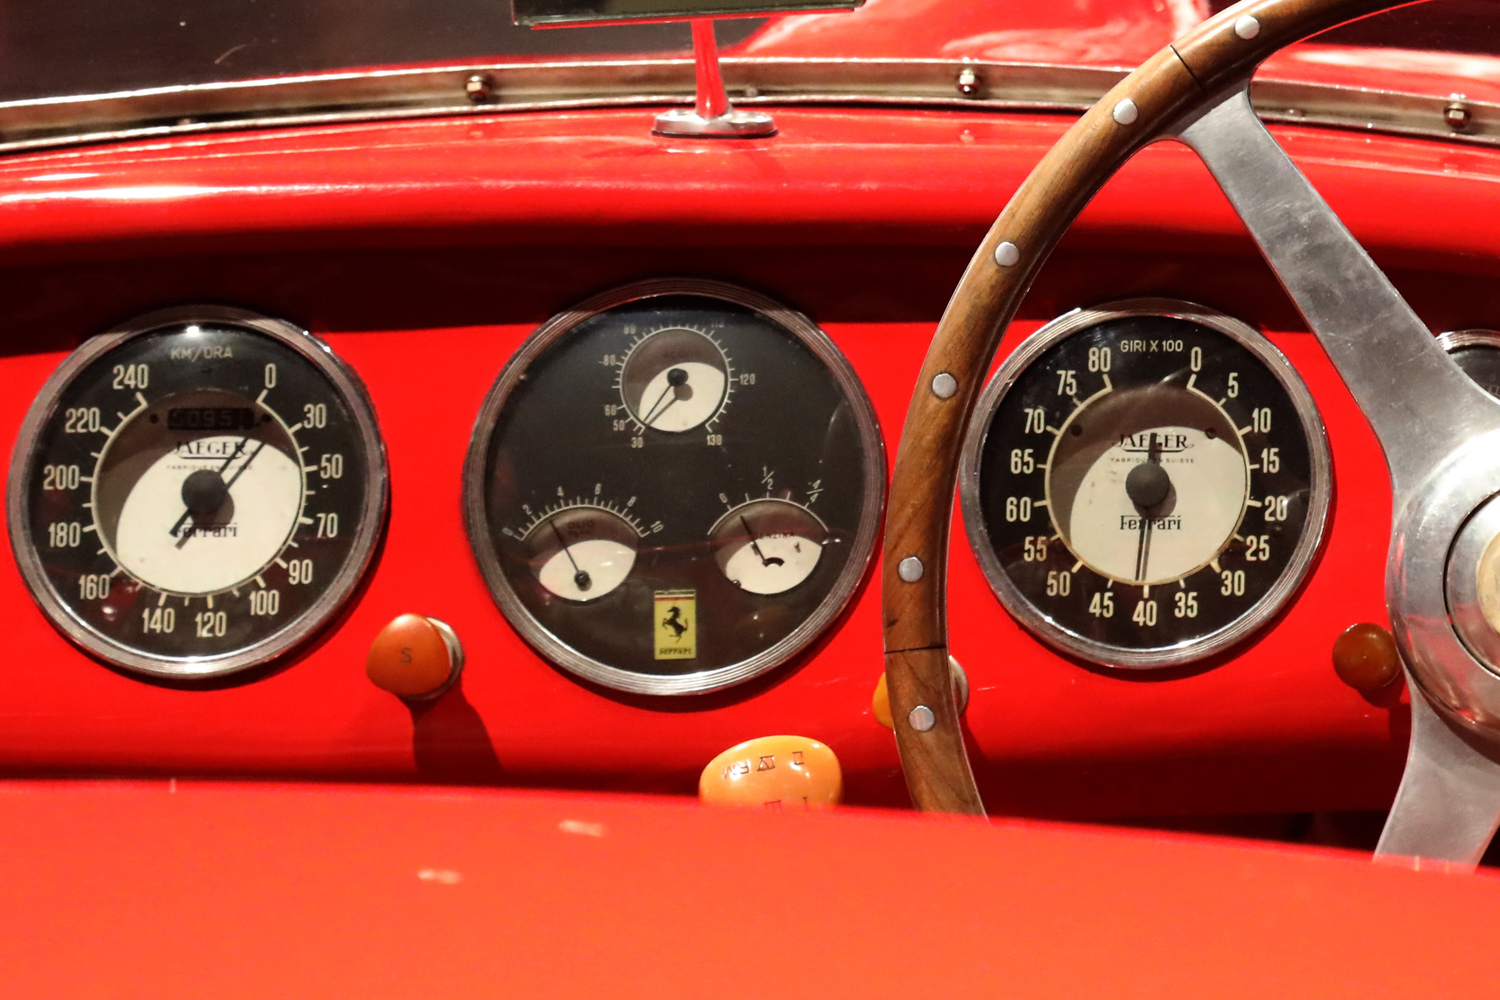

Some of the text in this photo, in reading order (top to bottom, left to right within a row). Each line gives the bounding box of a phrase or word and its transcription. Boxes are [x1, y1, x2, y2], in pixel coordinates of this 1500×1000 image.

[170, 346, 233, 362] KM/ORA
[1120, 339, 1183, 352] GIRI X 100
[603, 354, 616, 366] 80
[1088, 346, 1111, 373] 80
[1190, 346, 1202, 371] 0
[113, 364, 149, 389] 240
[264, 363, 276, 388] 0
[739, 373, 756, 385] 120
[1056, 370, 1077, 396] 75
[1227, 373, 1239, 398] 5
[65, 407, 100, 433] 220
[303, 403, 326, 428] 30
[604, 404, 617, 416] 60
[1024, 408, 1045, 434] 70
[1252, 408, 1271, 433] 10
[613, 420, 625, 431] 50
[631, 437, 644, 448] 30
[706, 434, 723, 446] 130
[320, 454, 343, 479] 50
[1010, 449, 1034, 474] 65
[1261, 448, 1280, 473] 15
[43, 465, 79, 490] 200
[594, 483, 602, 495] 6
[556, 485, 564, 497] 4
[627, 496, 637, 507] 8
[719, 492, 728, 504] 0
[522, 504, 532, 516] 2
[1005, 496, 1031, 522] 60
[1264, 496, 1288, 522] 20
[48, 523, 80, 547] 180
[316, 513, 338, 538] 70
[502, 527, 513, 537] 0
[650, 521, 664, 534] 10
[1024, 537, 1047, 562] 55
[1246, 535, 1270, 561] 25
[288, 559, 313, 584] 90
[1046, 570, 1070, 596] 50
[1221, 570, 1245, 596] 30
[79, 575, 110, 599] 160
[249, 590, 279, 615] 100
[1089, 592, 1114, 618] 45
[1132, 601, 1157, 626] 40
[1174, 592, 1198, 618] 35
[142, 608, 175, 634] 140
[195, 612, 227, 637] 120
[400, 646, 413, 665] S
